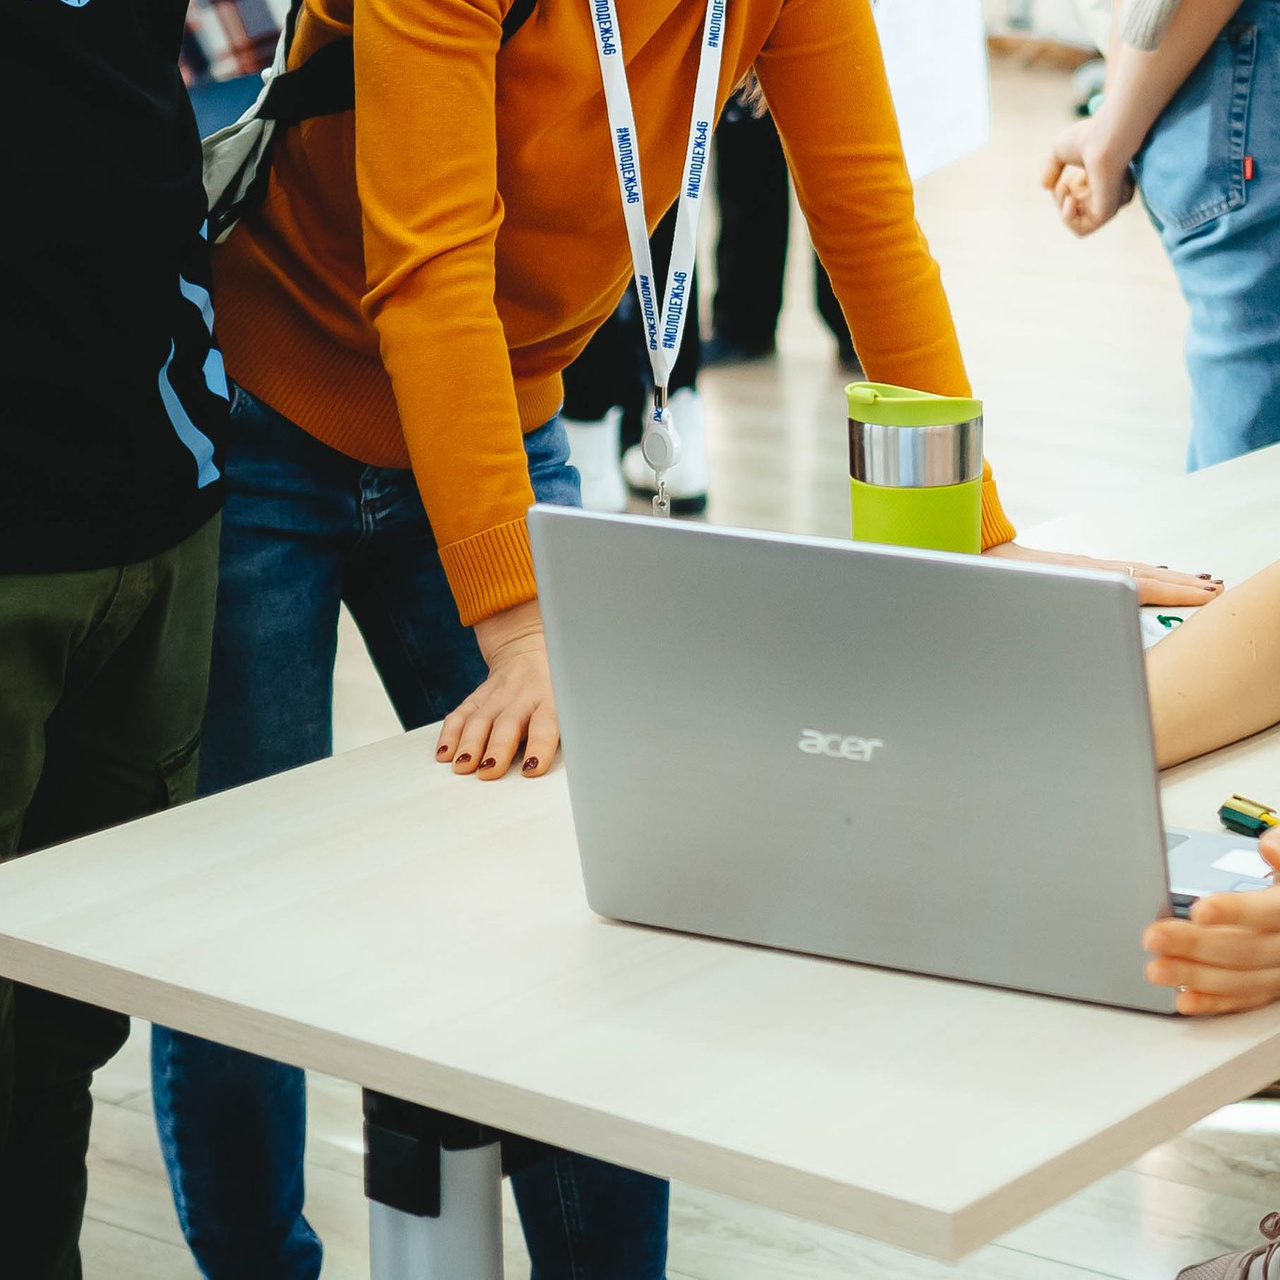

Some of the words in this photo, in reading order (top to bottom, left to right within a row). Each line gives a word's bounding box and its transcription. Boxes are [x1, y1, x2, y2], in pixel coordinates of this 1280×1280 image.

[615, 126, 640, 204] #МОЛОДЕЖЬ46
[686, 120, 709, 199] #МОЛОДЕЖЬ46
[662, 271, 688, 349] #МОЛОДЕЖЬ46
[799, 728, 884, 762] acer
